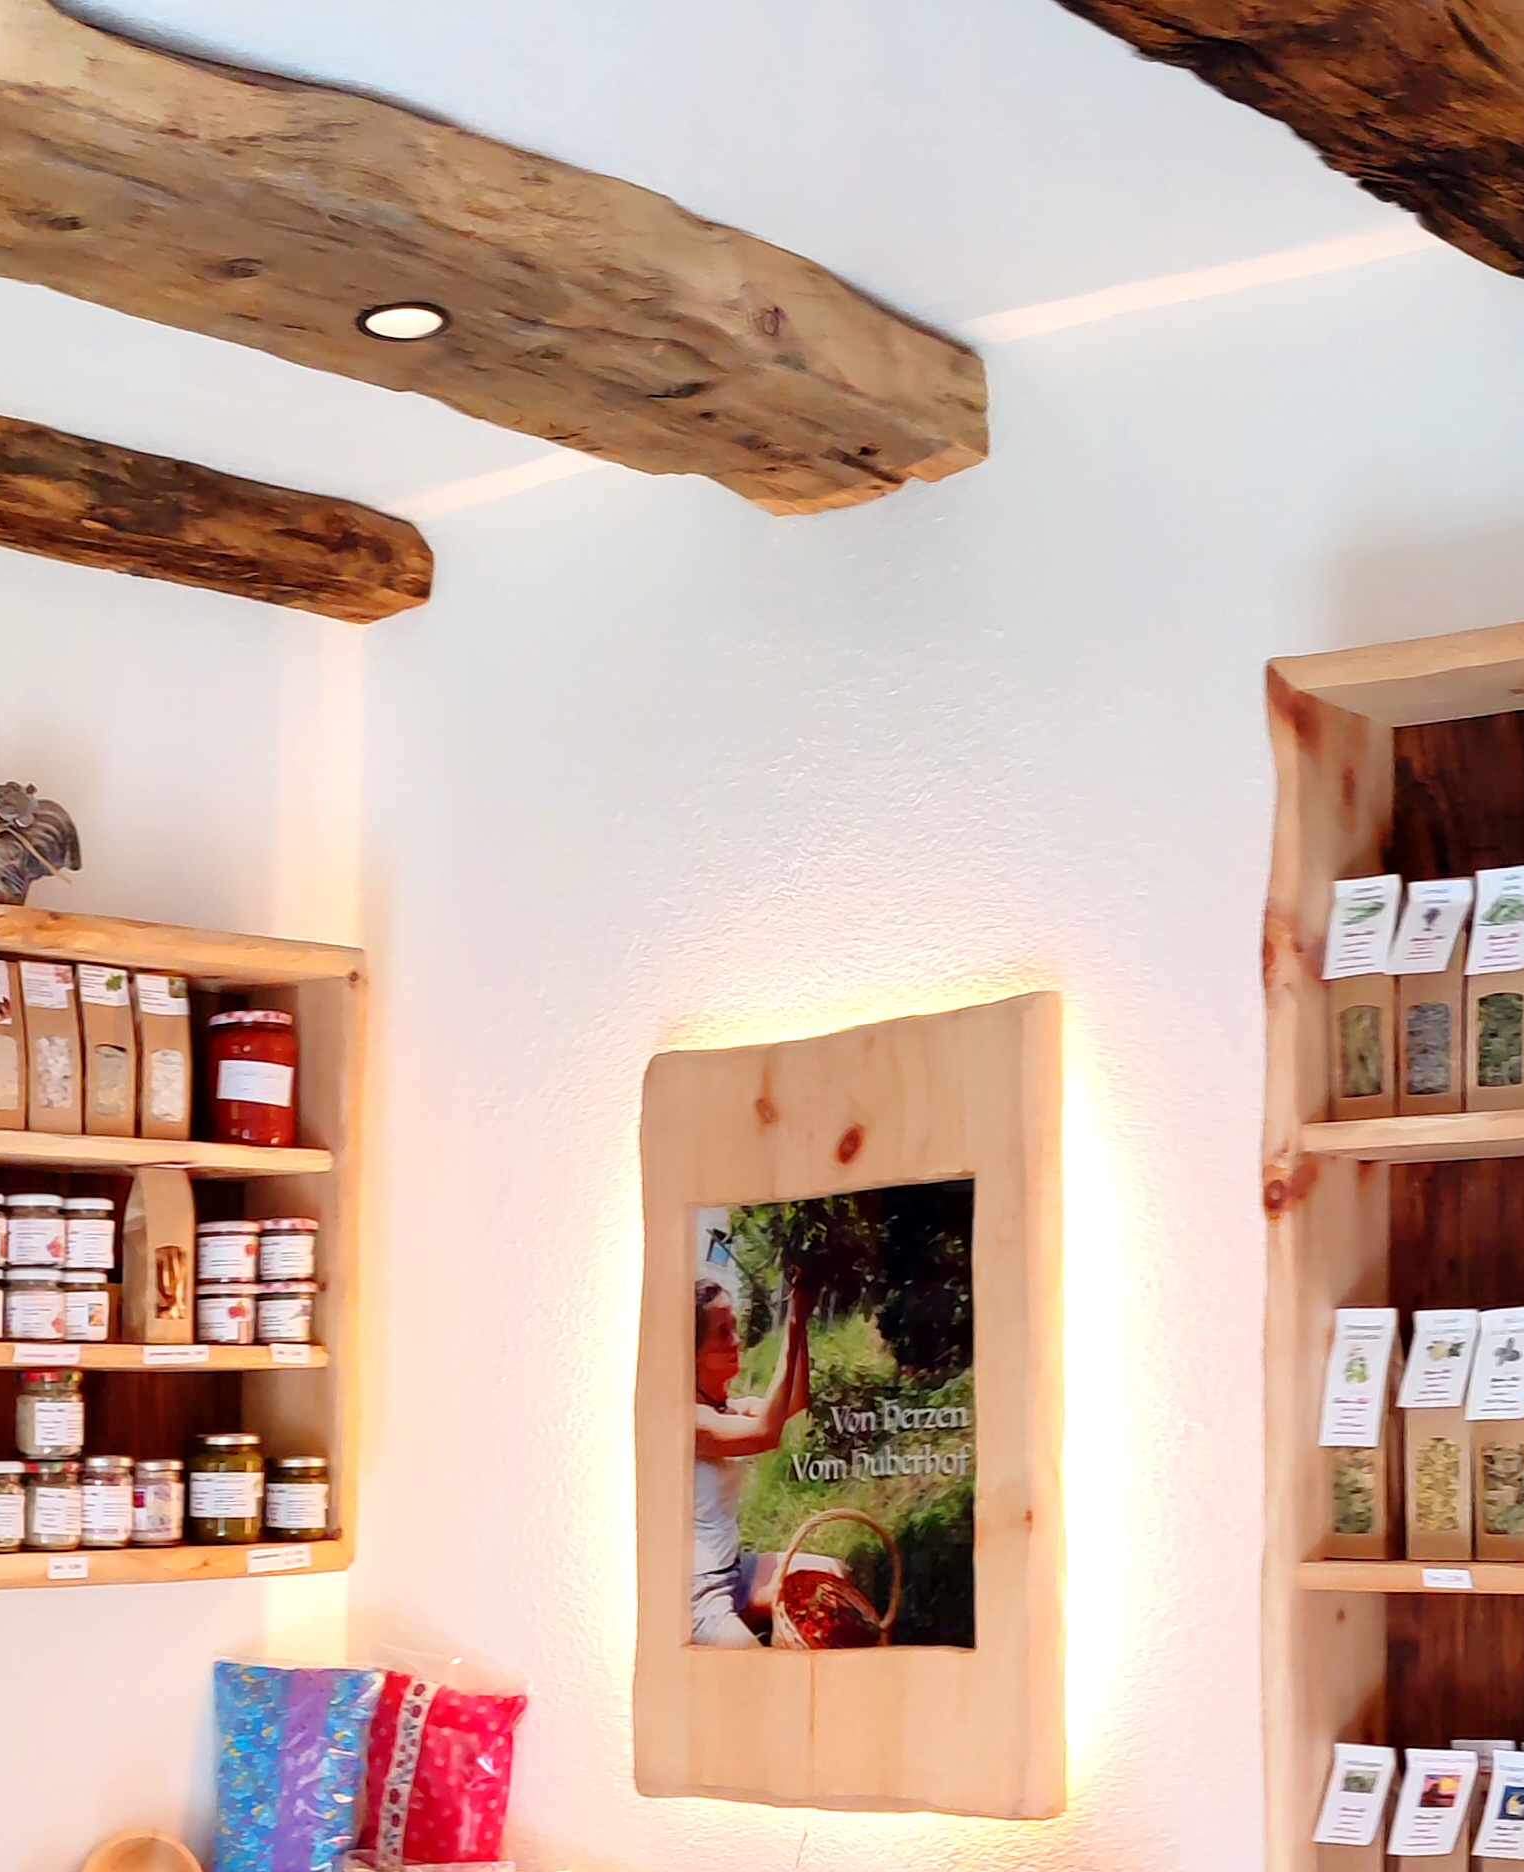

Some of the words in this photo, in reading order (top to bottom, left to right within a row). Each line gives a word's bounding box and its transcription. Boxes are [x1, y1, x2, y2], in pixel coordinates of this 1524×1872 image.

[831, 1405, 877, 1435] Von
[882, 1399, 971, 1434] Herzen
[791, 1453, 847, 1481] Vom
[851, 1443, 972, 1481] Huberhof
